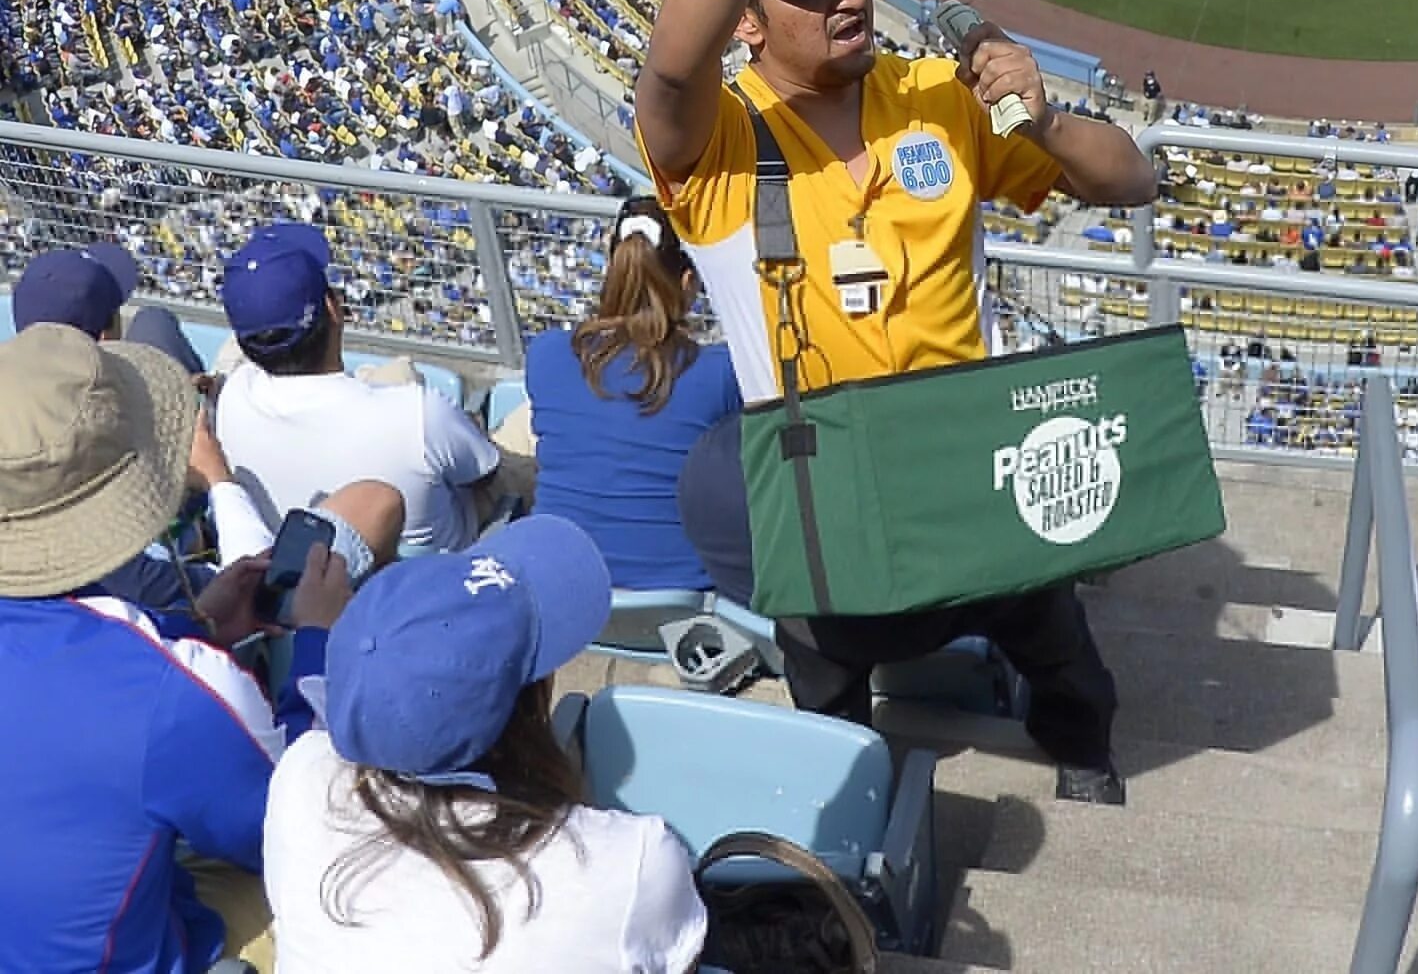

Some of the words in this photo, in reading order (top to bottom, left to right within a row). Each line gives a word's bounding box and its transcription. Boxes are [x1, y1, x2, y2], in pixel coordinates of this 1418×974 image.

[896, 140, 943, 168] PEANUTS
[901, 160, 951, 189] 6.00
[992, 413, 1128, 491] Peanuts
[1042, 481, 1113, 532] ROASTED
